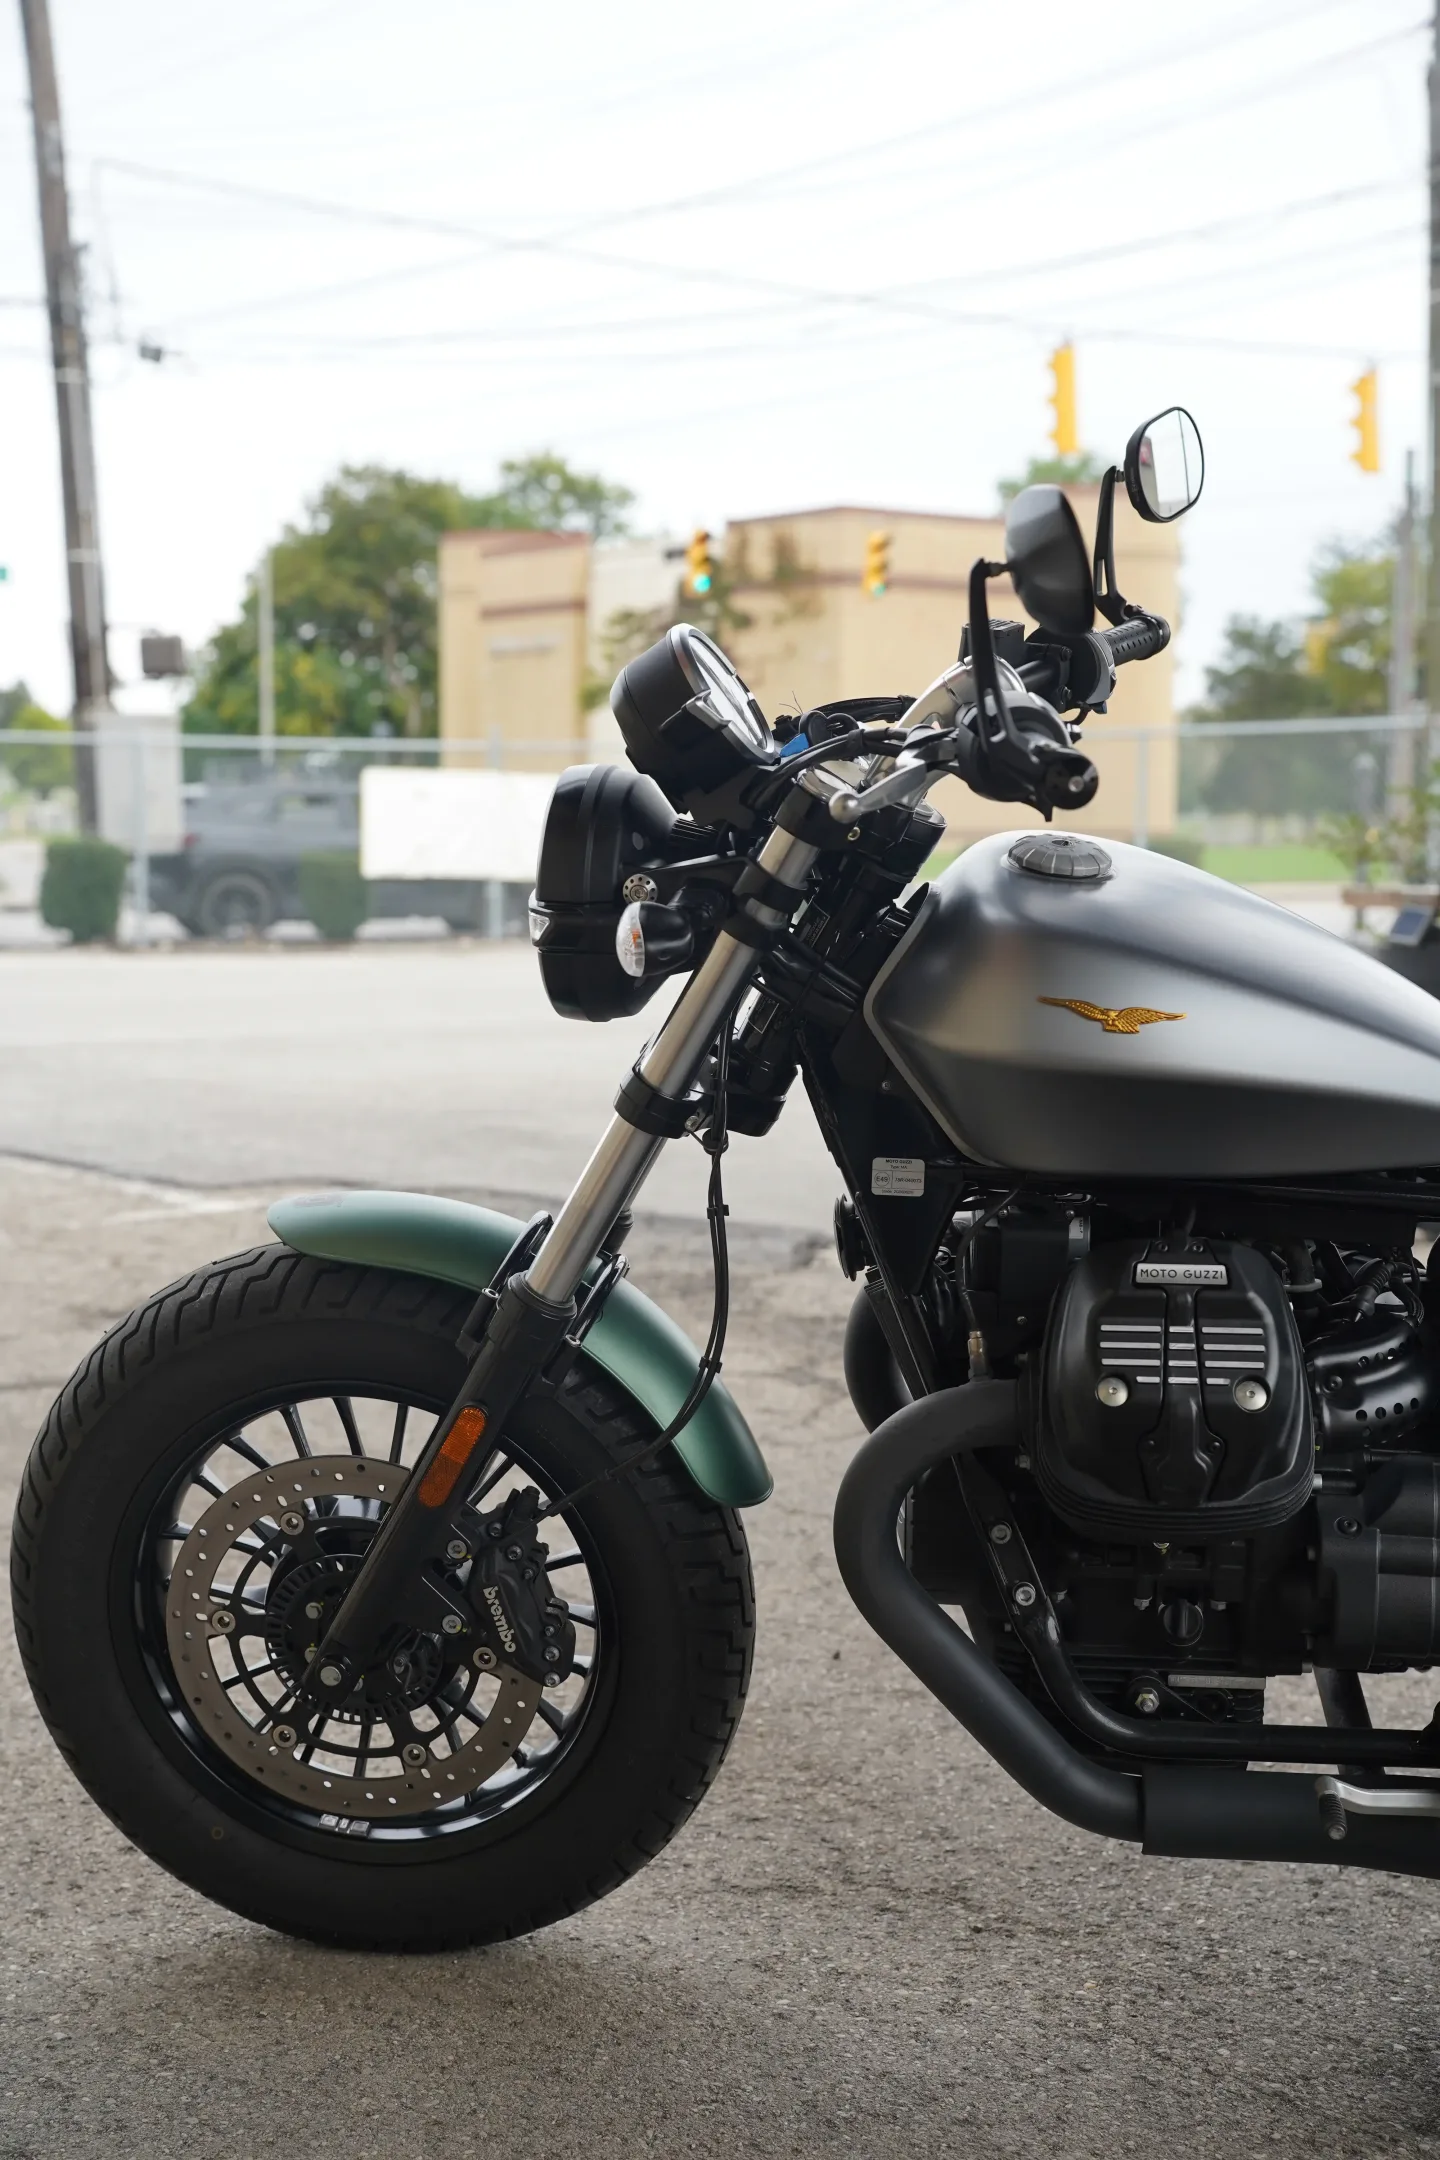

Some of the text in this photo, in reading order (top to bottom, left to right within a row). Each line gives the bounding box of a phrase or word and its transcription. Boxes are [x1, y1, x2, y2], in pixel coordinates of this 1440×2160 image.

[1140, 1268, 1223, 1280] MOTO GUZZI
[483, 1585, 516, 1653] brembo
